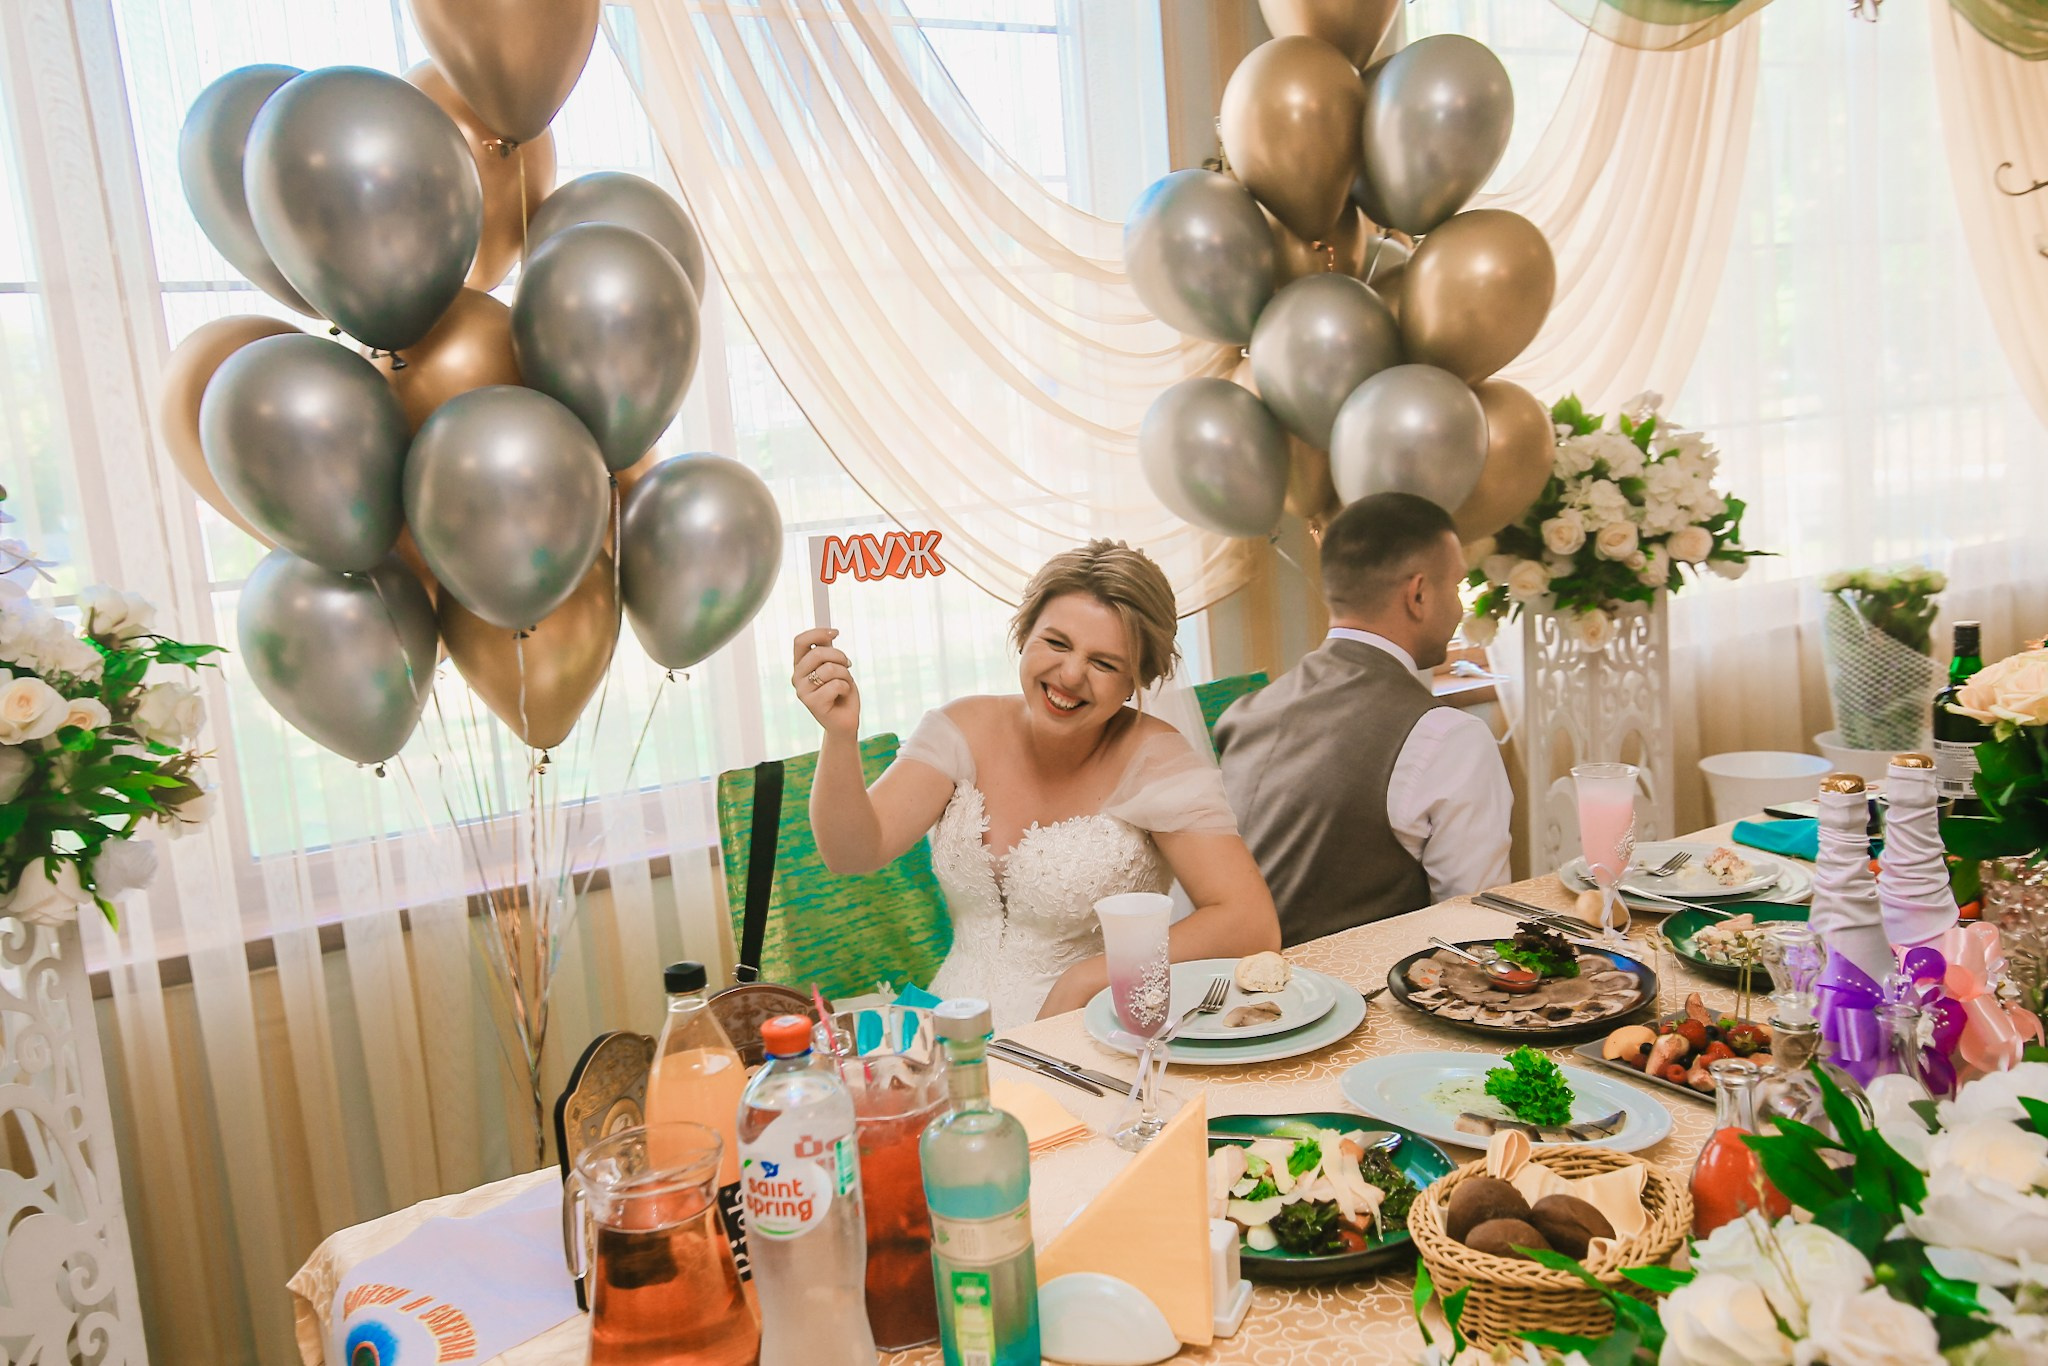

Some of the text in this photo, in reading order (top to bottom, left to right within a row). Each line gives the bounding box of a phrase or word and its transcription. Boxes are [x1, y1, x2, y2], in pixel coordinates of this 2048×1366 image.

[823, 532, 943, 582] МУЖ
[748, 1178, 803, 1197] saint
[746, 1195, 813, 1222] spring
[400, 1296, 433, 1312] И
[418, 1303, 476, 1363] СОХРАНИ
